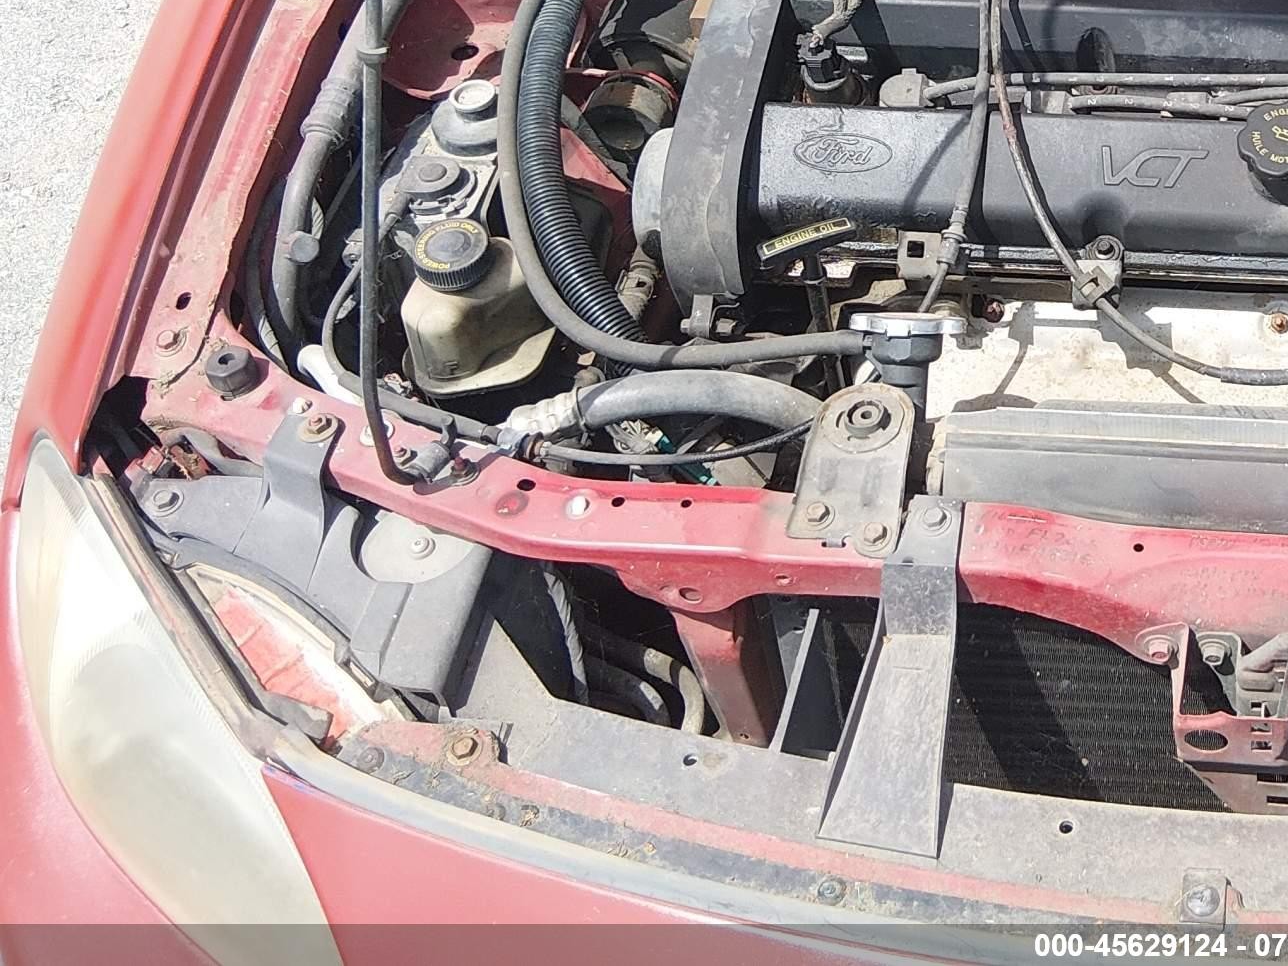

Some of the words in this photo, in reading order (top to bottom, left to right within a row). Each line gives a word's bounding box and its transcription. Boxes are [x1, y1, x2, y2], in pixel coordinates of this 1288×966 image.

[796, 138, 875, 168] Ford
[1251, 130, 1270, 156] HUILE
[1100, 147, 1210, 189] VCT
[415, 228, 436, 259] STEERING
[774, 229, 817, 249] ENGINE
[819, 222, 836, 235] OIL
[421, 256, 451, 270] POWER
